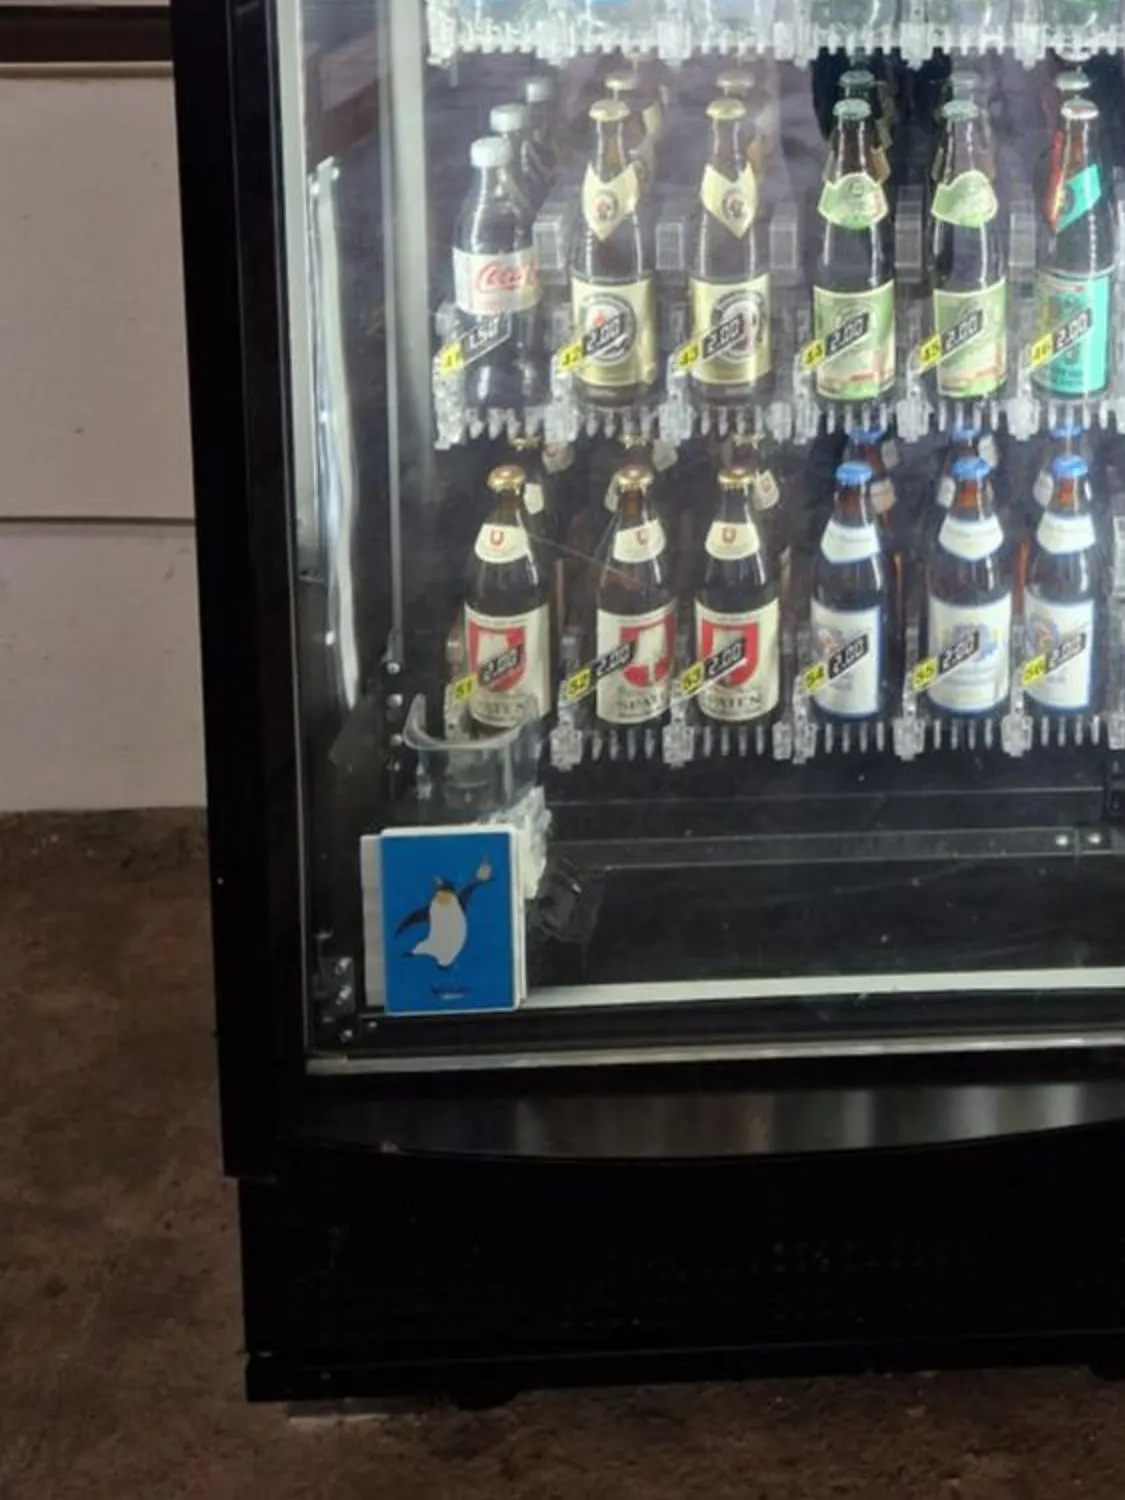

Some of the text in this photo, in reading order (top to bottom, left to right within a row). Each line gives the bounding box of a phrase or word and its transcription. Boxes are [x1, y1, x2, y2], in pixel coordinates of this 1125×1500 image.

[830, 318, 865, 349] 2.00
[945, 315, 978, 349] 2.00
[1056, 312, 1089, 348] 2.00
